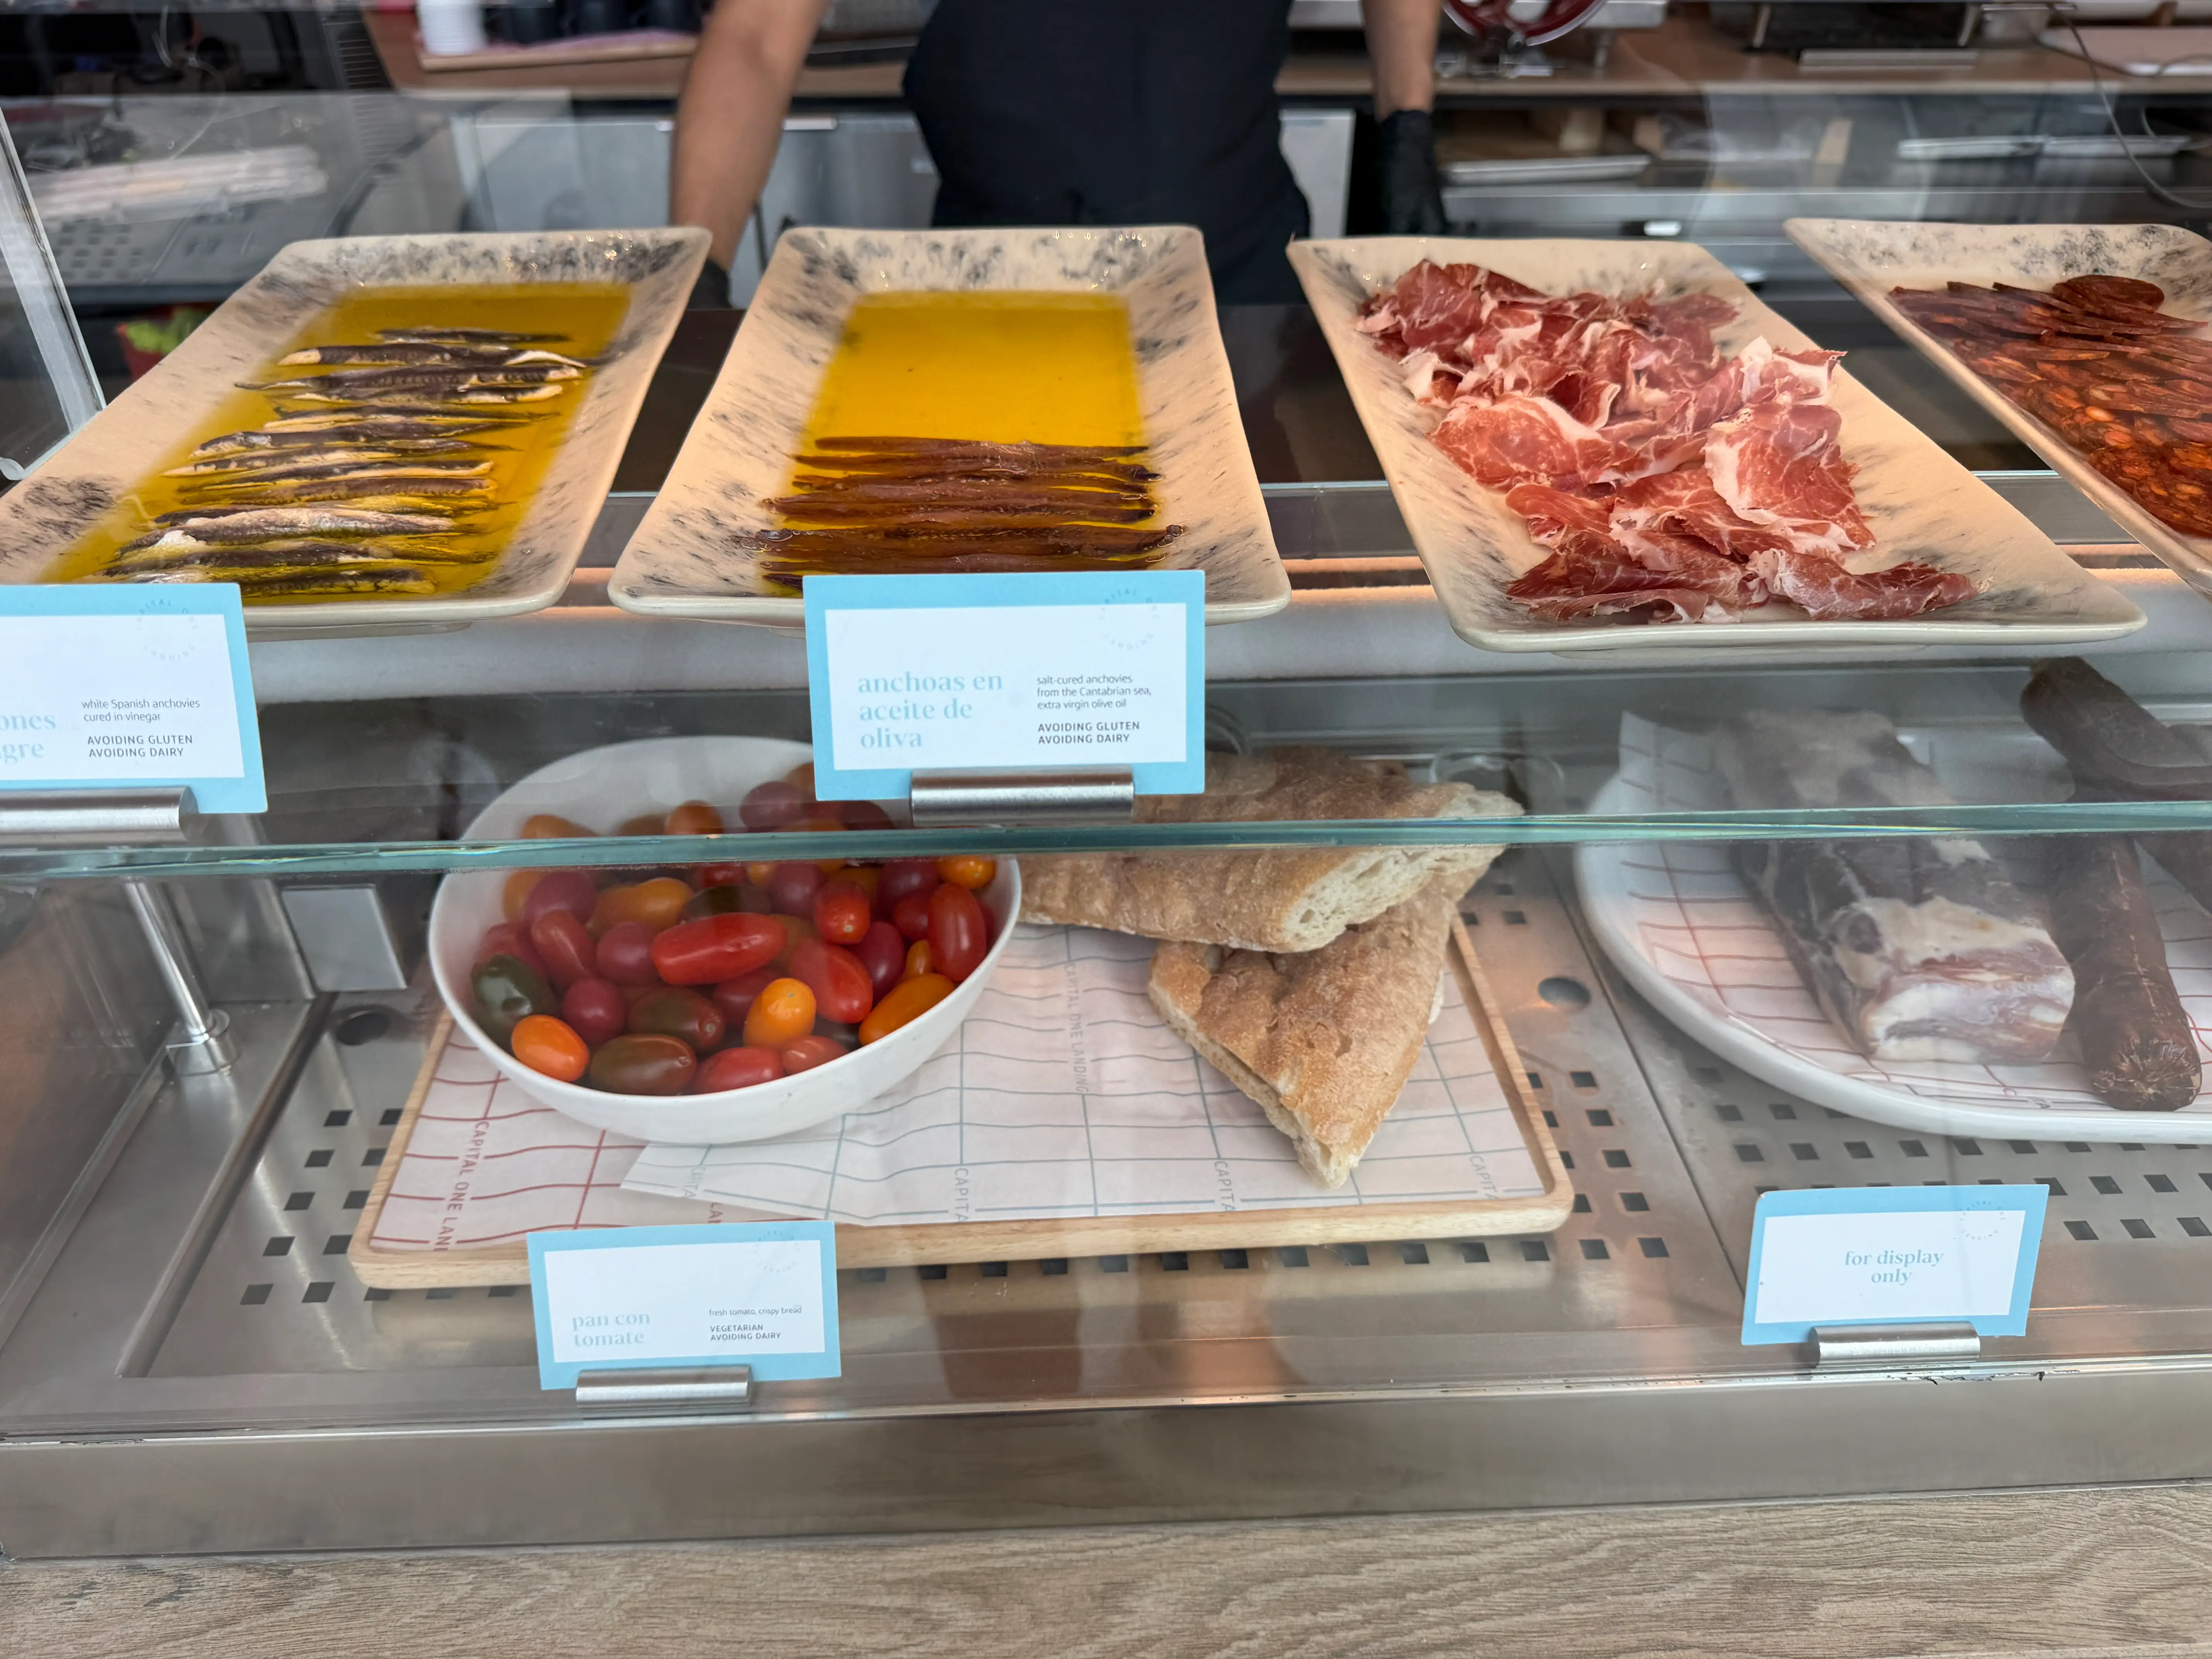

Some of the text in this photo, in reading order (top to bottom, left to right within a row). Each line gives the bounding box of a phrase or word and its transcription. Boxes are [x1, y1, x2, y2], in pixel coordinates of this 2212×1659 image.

[135, 598, 172, 631] CAPITAL
[858, 671, 1003, 693] anchoas en
[1037, 674, 1132, 685] salt-cured anchovies
[1037, 687, 1152, 697] from the Cantabrian sea,
[82, 698, 200, 710] white Spanish anchovies
[859, 698, 973, 721] aceite de
[1037, 698, 1127, 711] extra virgin olive oil
[84, 711, 161, 723] cured in vinegar
[1037, 721, 1140, 732] AVOIDING GLUTEN
[88, 735, 193, 745] AVOIDING GLUTEN
[860, 727, 922, 749] oliva
[1038, 734, 1130, 744] AVOIDING DAIRY
[0, 743, 45, 765] gre
[89, 747, 184, 757] AVOIDING DAIRY
[1065, 962, 1089, 1094] CAPITAL ONE LANDING
[433, 1121, 490, 1252] CAPITAL ONE LAN
[954, 1168, 969, 1221] CAPITA
[1844, 1249, 1944, 1267] for display
[1871, 1269, 1912, 1286] only
[759, 1307, 779, 1316] crispy
[572, 1314, 650, 1331] pan con
[575, 1332, 644, 1347] tomate
[711, 1333, 752, 1341] AVOIDING
